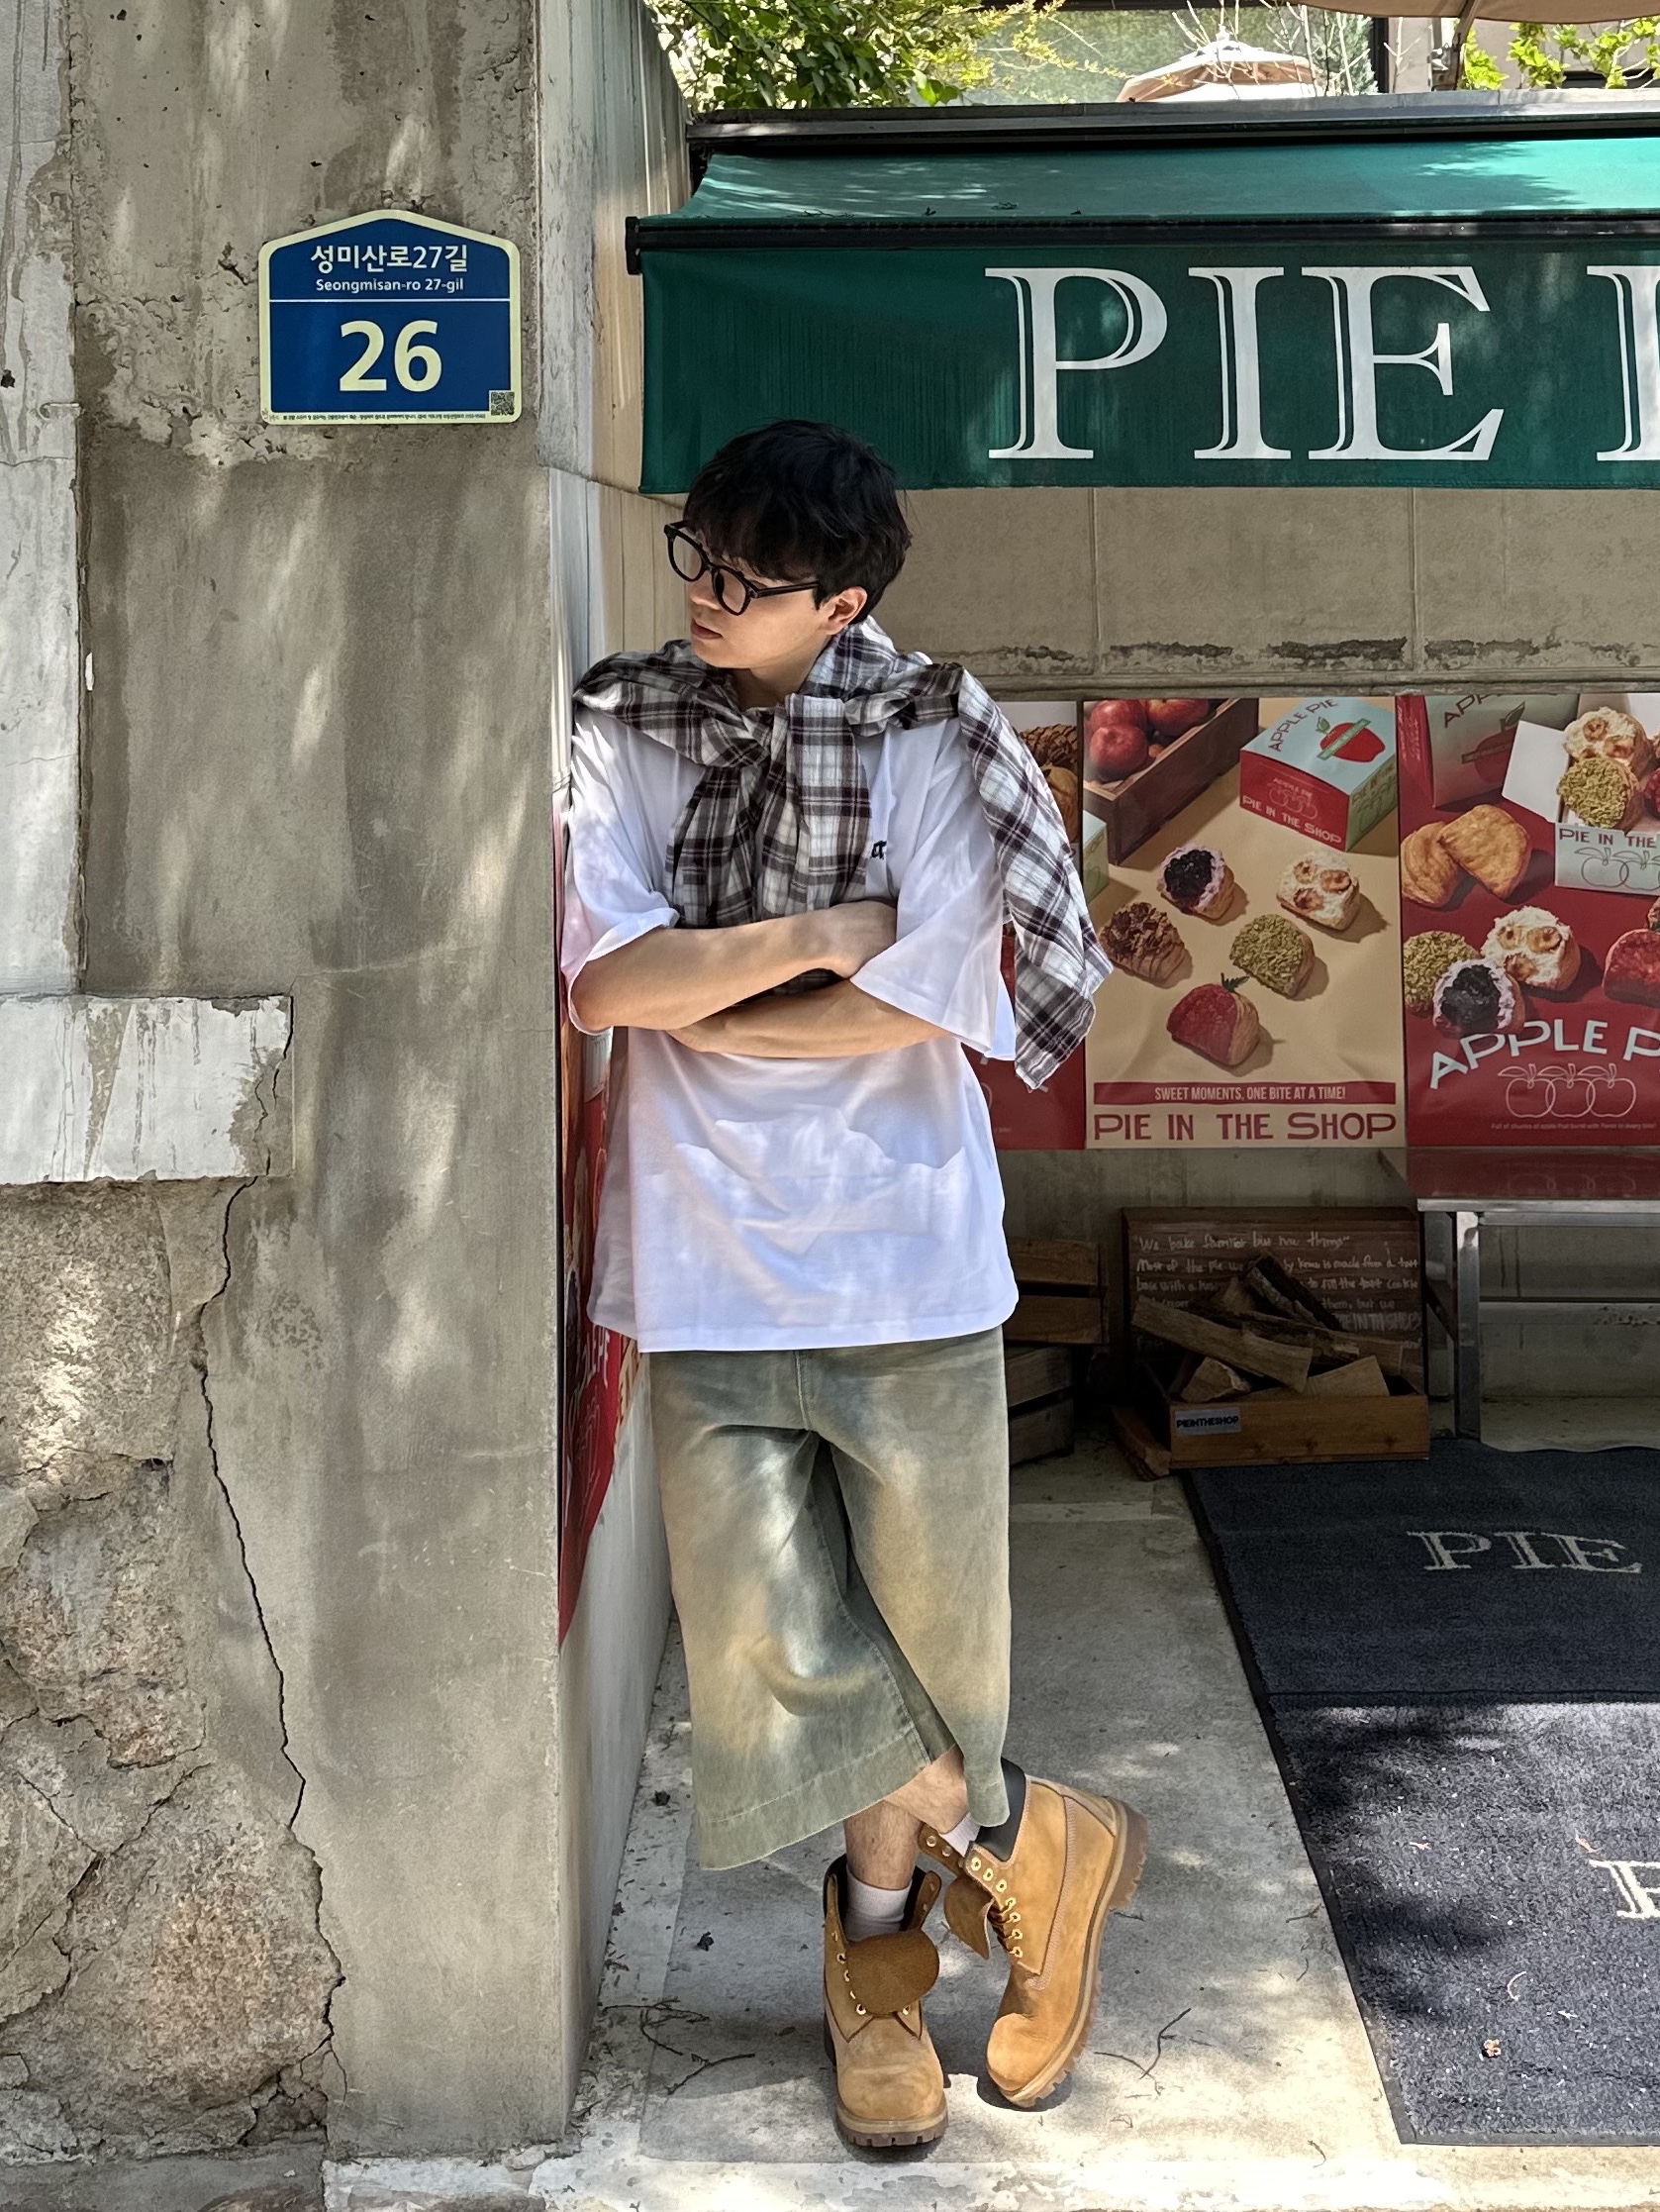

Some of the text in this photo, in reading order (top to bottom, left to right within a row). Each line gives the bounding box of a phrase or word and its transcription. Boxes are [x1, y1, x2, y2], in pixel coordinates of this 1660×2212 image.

[311, 245, 467, 274] 성미산로27길
[316, 278, 464, 294] Seongmisan-ro 27-gil
[339, 320, 442, 393] 26
[985, 266, 1504, 460] PIE
[1268, 698, 1338, 753] APPLE PIE
[1242, 795, 1342, 844] PIE IN THE SHOP
[1559, 828, 1657, 849] PIE IN THE
[1429, 1019, 1609, 1090] APPLE
[1154, 1086, 1346, 1101] SWEET MOMENTS, ONE BITE AT A TIME!
[1094, 1111, 1397, 1141] PIE IN THE SHOP
[1406, 1530, 1643, 1574] PIE
